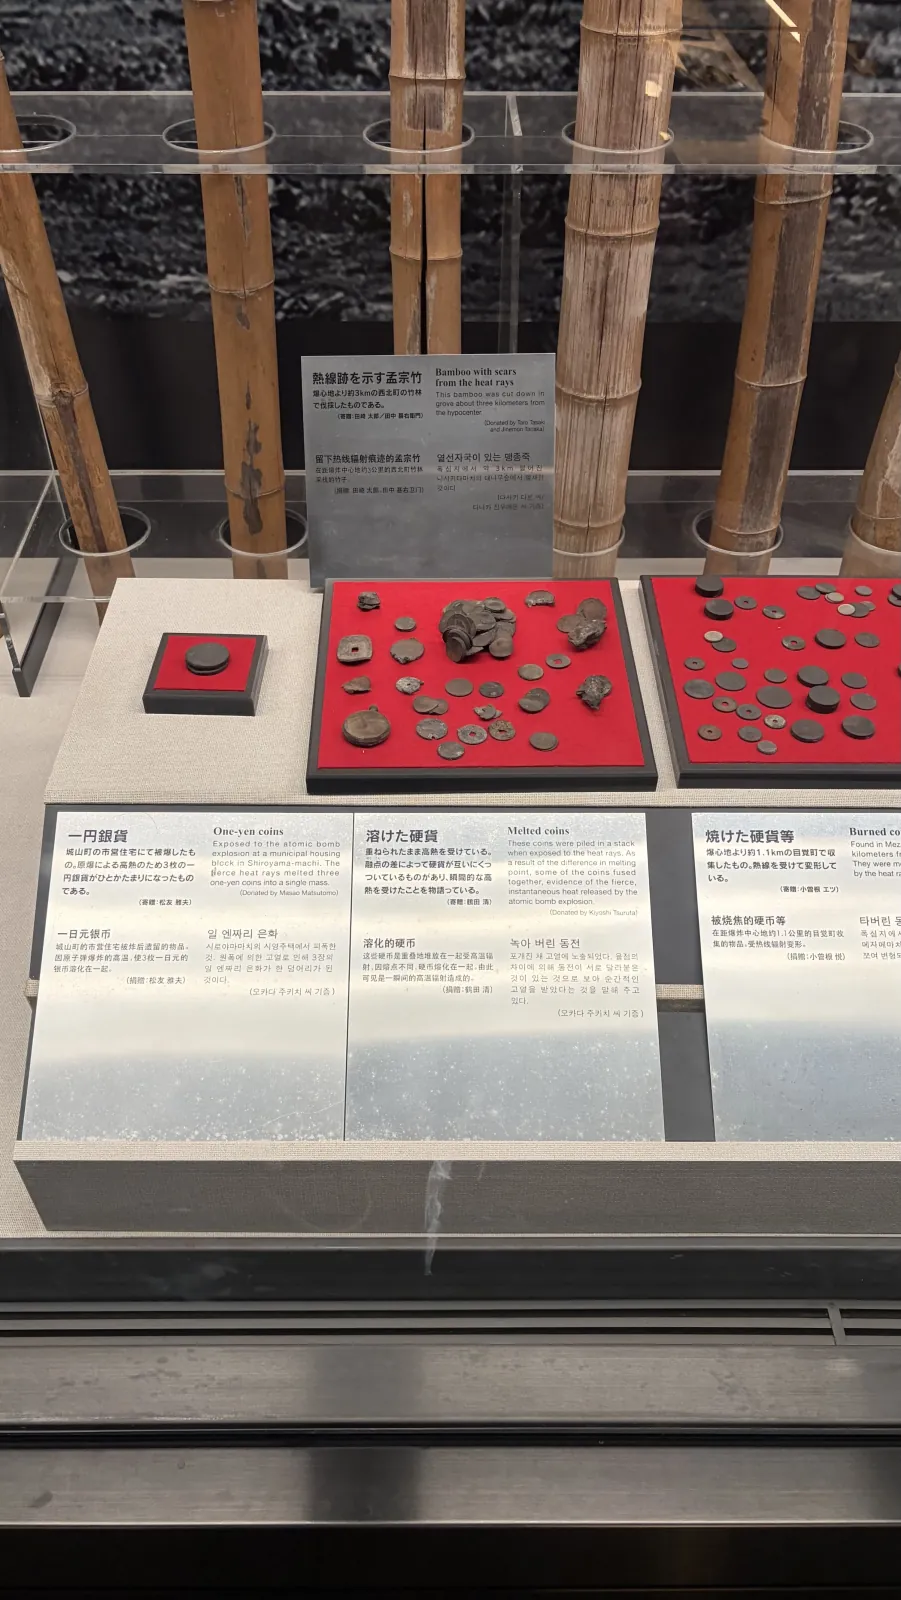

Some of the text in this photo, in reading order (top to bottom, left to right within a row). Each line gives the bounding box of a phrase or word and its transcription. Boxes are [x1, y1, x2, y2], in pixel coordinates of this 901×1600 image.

[436, 368, 516, 376] Bamboo with scars
[313, 371, 422, 384] 熱線跡を示す孟宗竹
[496, 380, 514, 388] rays
[437, 453, 501, 462] 열선자국이 있는
[213, 827, 283, 837] One-yen coins
[508, 827, 569, 835] Melted coins
[849, 828, 886, 836] Burned
[69, 830, 128, 843] 一円銀貨
[366, 830, 438, 843] 溶けた硬貨
[706, 830, 794, 843] 焼けた硬貨等
[66, 848, 195, 856] 城山町の市営住宅にて被爆したも
[708, 862, 836, 870] 集したもの。熱線を受けて変形して
[853, 860, 870, 868] They
[64, 874, 194, 882] 円銀貨がひとかたまりになったもの
[708, 874, 728, 883] いる。
[854, 870, 862, 878] by
[365, 886, 479, 894] 熱を受けたことを物語っている。
[711, 916, 786, 926] 被烧焦的硬币等
[860, 916, 890, 926] 타버린
[58, 929, 111, 939] 一日元银币
[208, 929, 278, 939] 일 엔짜리 은화
[364, 938, 415, 948] 溶化的硬币
[510, 939, 580, 948] 녹아 버린 동전
